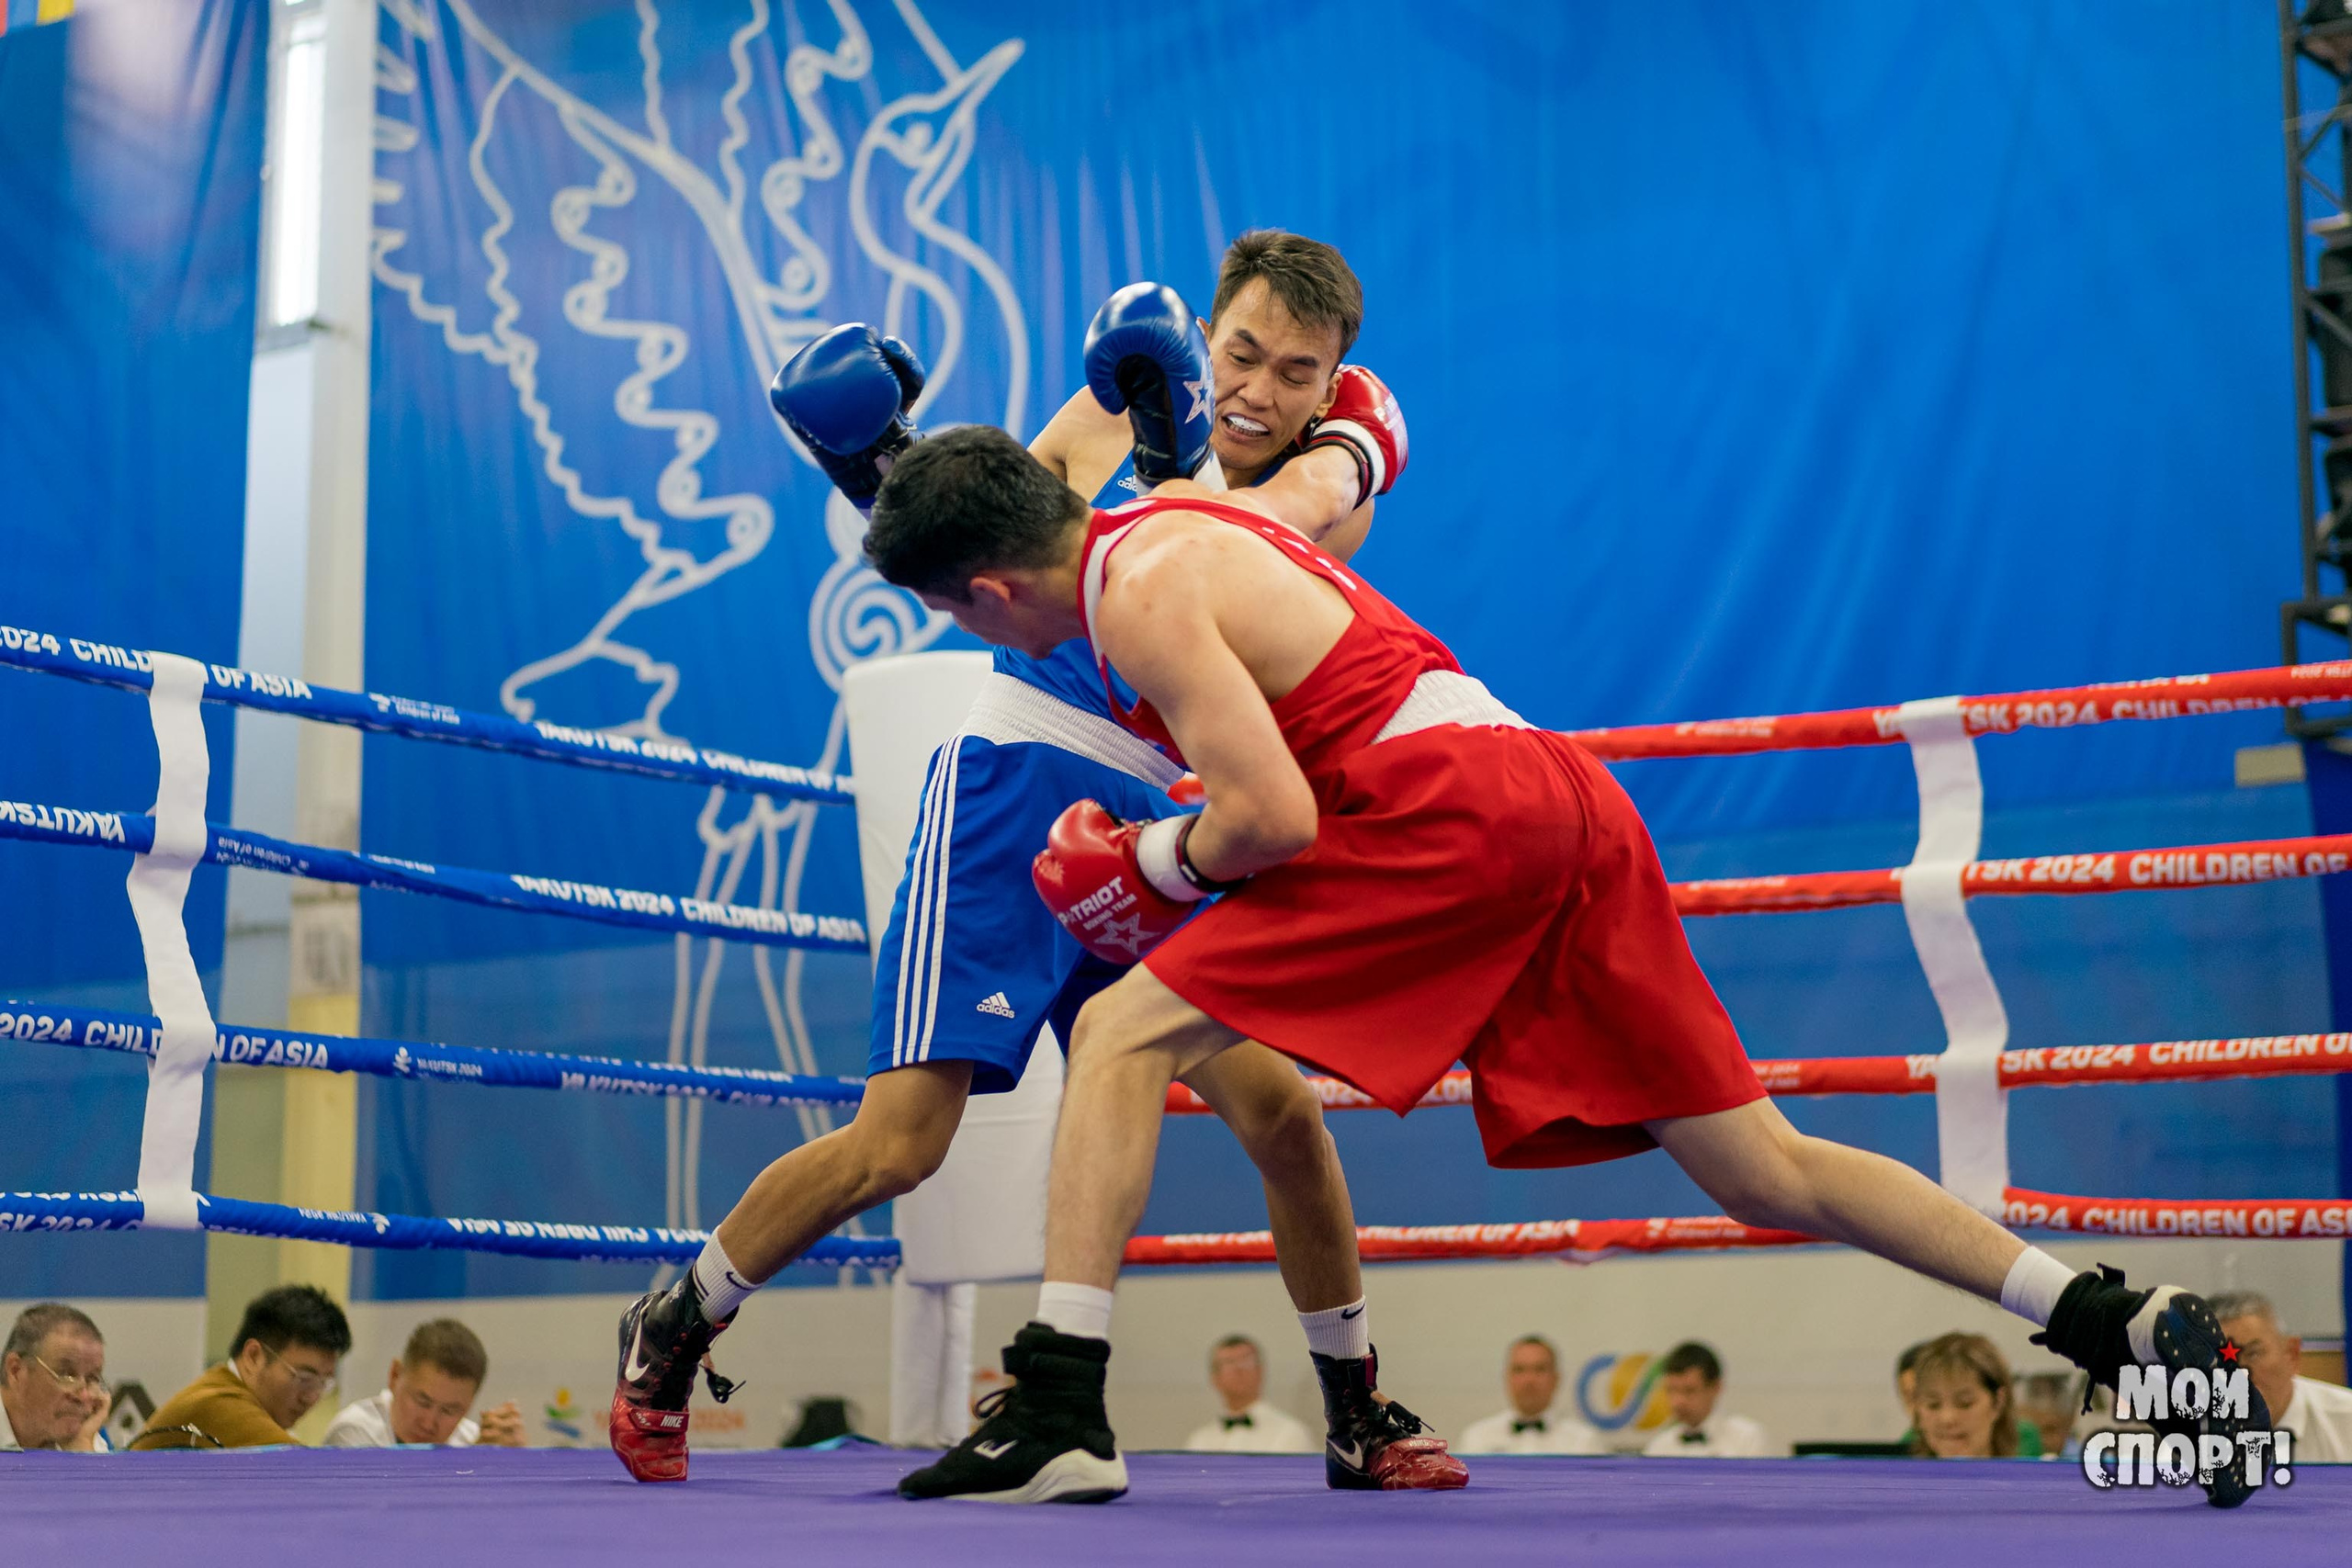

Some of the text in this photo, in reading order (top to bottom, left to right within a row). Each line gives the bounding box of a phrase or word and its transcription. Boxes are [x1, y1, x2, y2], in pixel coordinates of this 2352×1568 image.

[0, 626, 61, 656] 024
[250, 670, 312, 700] ASIA
[0, 800, 126, 843] YAKUTSK
[2029, 854, 2118, 883] 2024
[2129, 852, 2297, 883] CHILDREN
[976, 1002, 1015, 1020] adidas
[0, 1011, 73, 1042] 2024
[229, 1034, 267, 1062] OF
[261, 1039, 328, 1068] ASIA
[2050, 1043, 2133, 1069] 2024
[2149, 1034, 2318, 1065] CHILDREN
[2002, 1200, 2071, 1229] 024
[2081, 1205, 2247, 1236] CHILDREN
[2252, 1207, 2297, 1236] OF
[660, 1415, 685, 1429] NIKE
